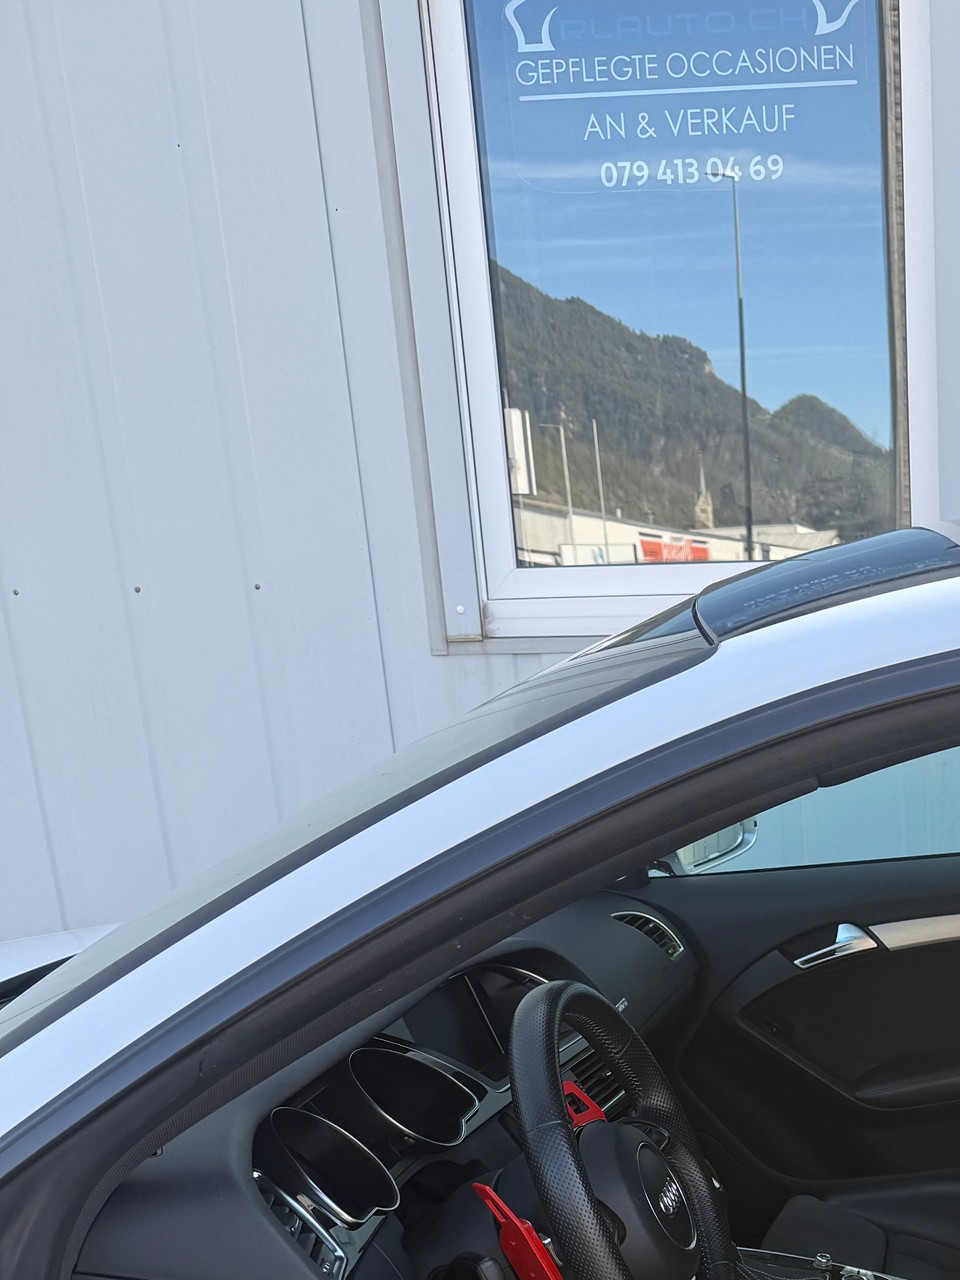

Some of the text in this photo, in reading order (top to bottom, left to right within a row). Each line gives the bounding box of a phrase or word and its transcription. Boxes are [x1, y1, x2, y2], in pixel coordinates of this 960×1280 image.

[515, 44, 855, 86] GEPFLEGTE OCCASIONEN
[584, 104, 796, 141] AN & VERKAUF
[600, 154, 785, 188] 079 413 04 69
